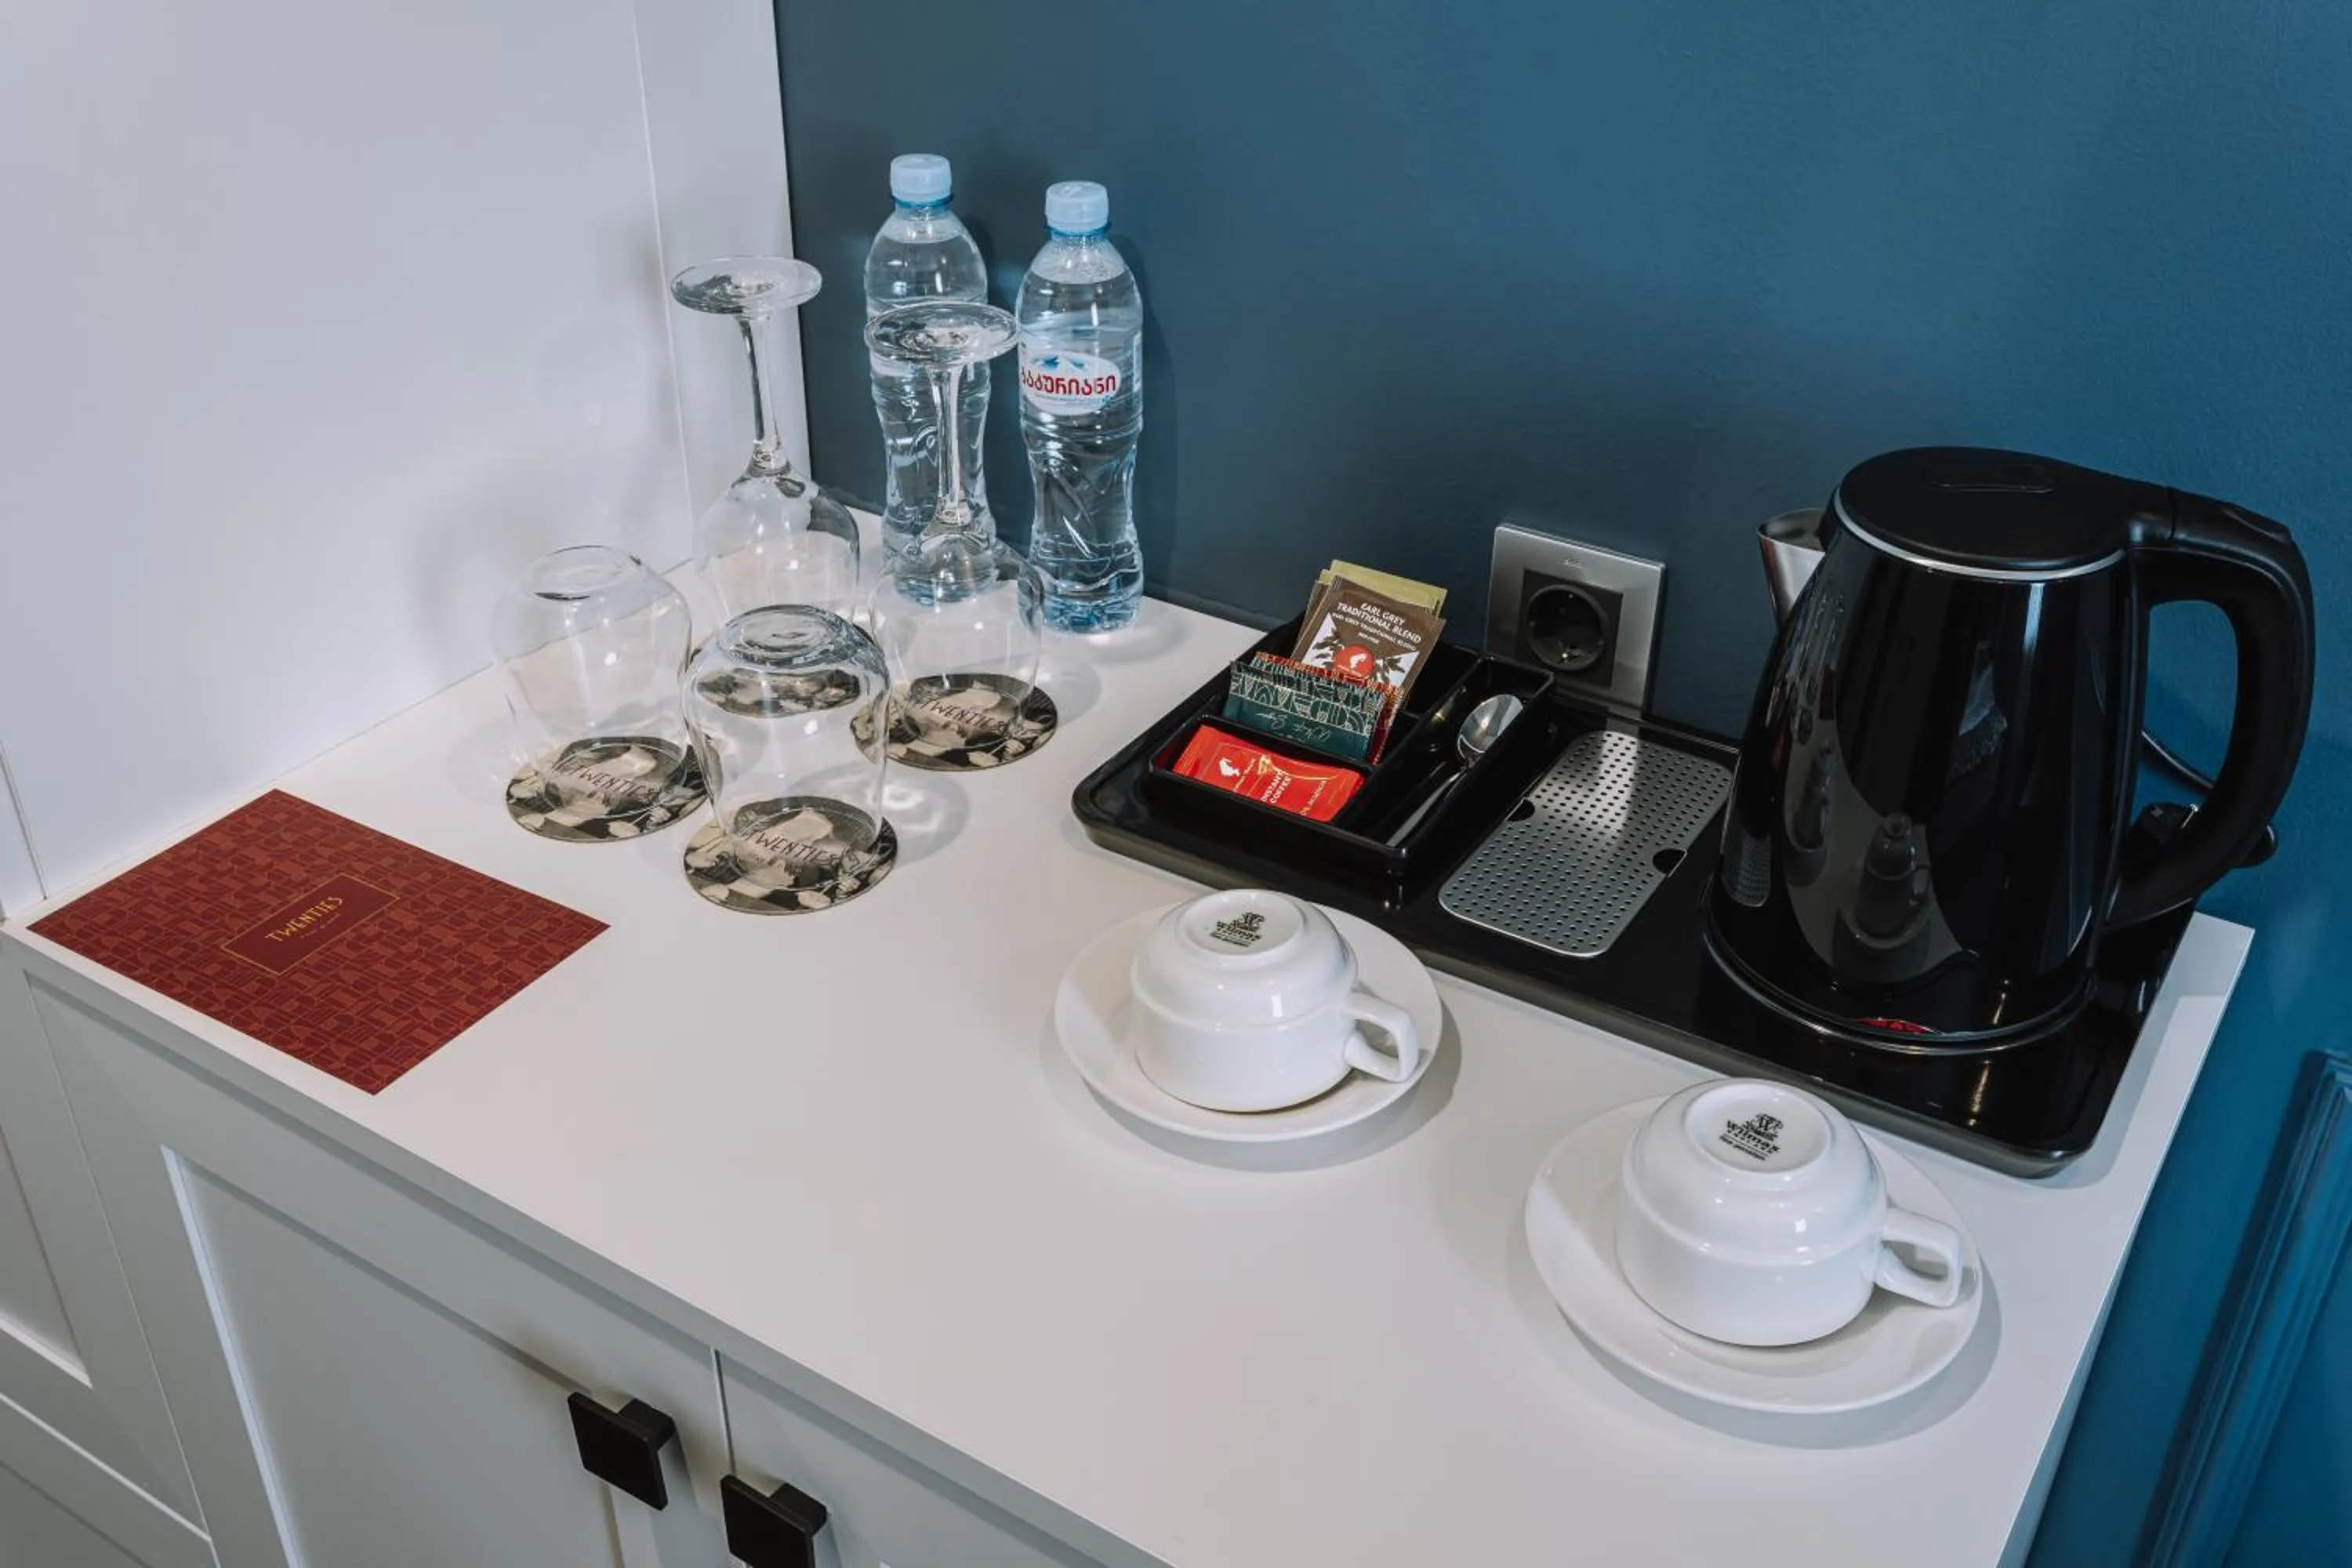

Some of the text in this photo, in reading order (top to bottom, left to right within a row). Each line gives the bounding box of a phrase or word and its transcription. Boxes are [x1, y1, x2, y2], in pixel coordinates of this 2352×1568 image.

[1336, 602, 1391, 629] TRADITIONAL
[1392, 624, 1422, 644] BLEND
[1359, 601, 1406, 626] EARL GREY
[919, 695, 1005, 735] TWENTIES
[573, 764, 659, 804] TWENTIES
[1269, 770, 1294, 804] COFFEE
[744, 829, 842, 866] TWENTIES
[264, 896, 343, 942] TWENTIES
